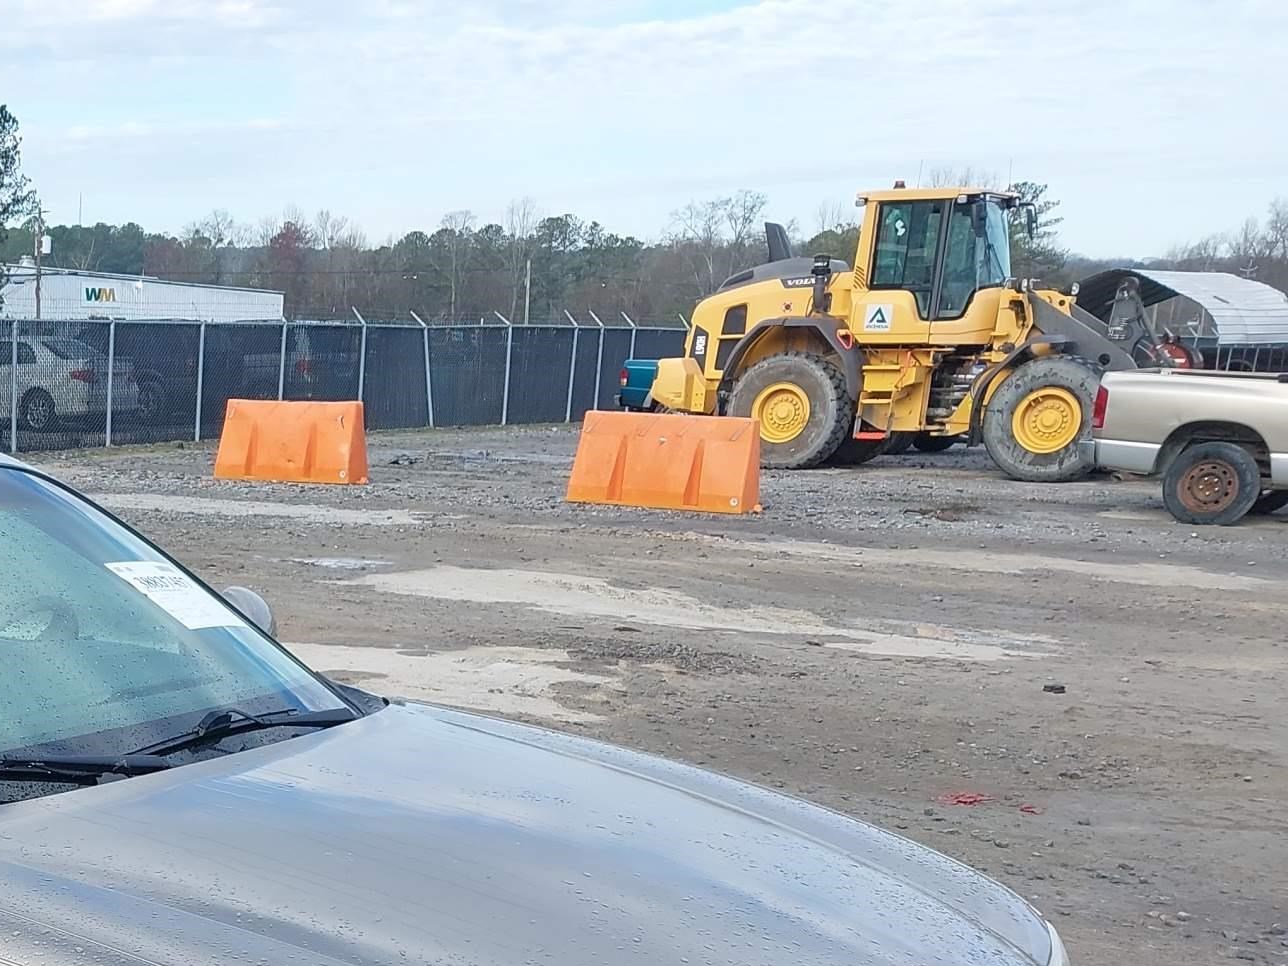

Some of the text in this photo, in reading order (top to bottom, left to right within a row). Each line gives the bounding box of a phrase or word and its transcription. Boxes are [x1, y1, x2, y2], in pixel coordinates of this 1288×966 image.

[787, 277, 827, 286] VOLV
[85, 287, 116, 302] WM
[695, 335, 706, 355] L90H
